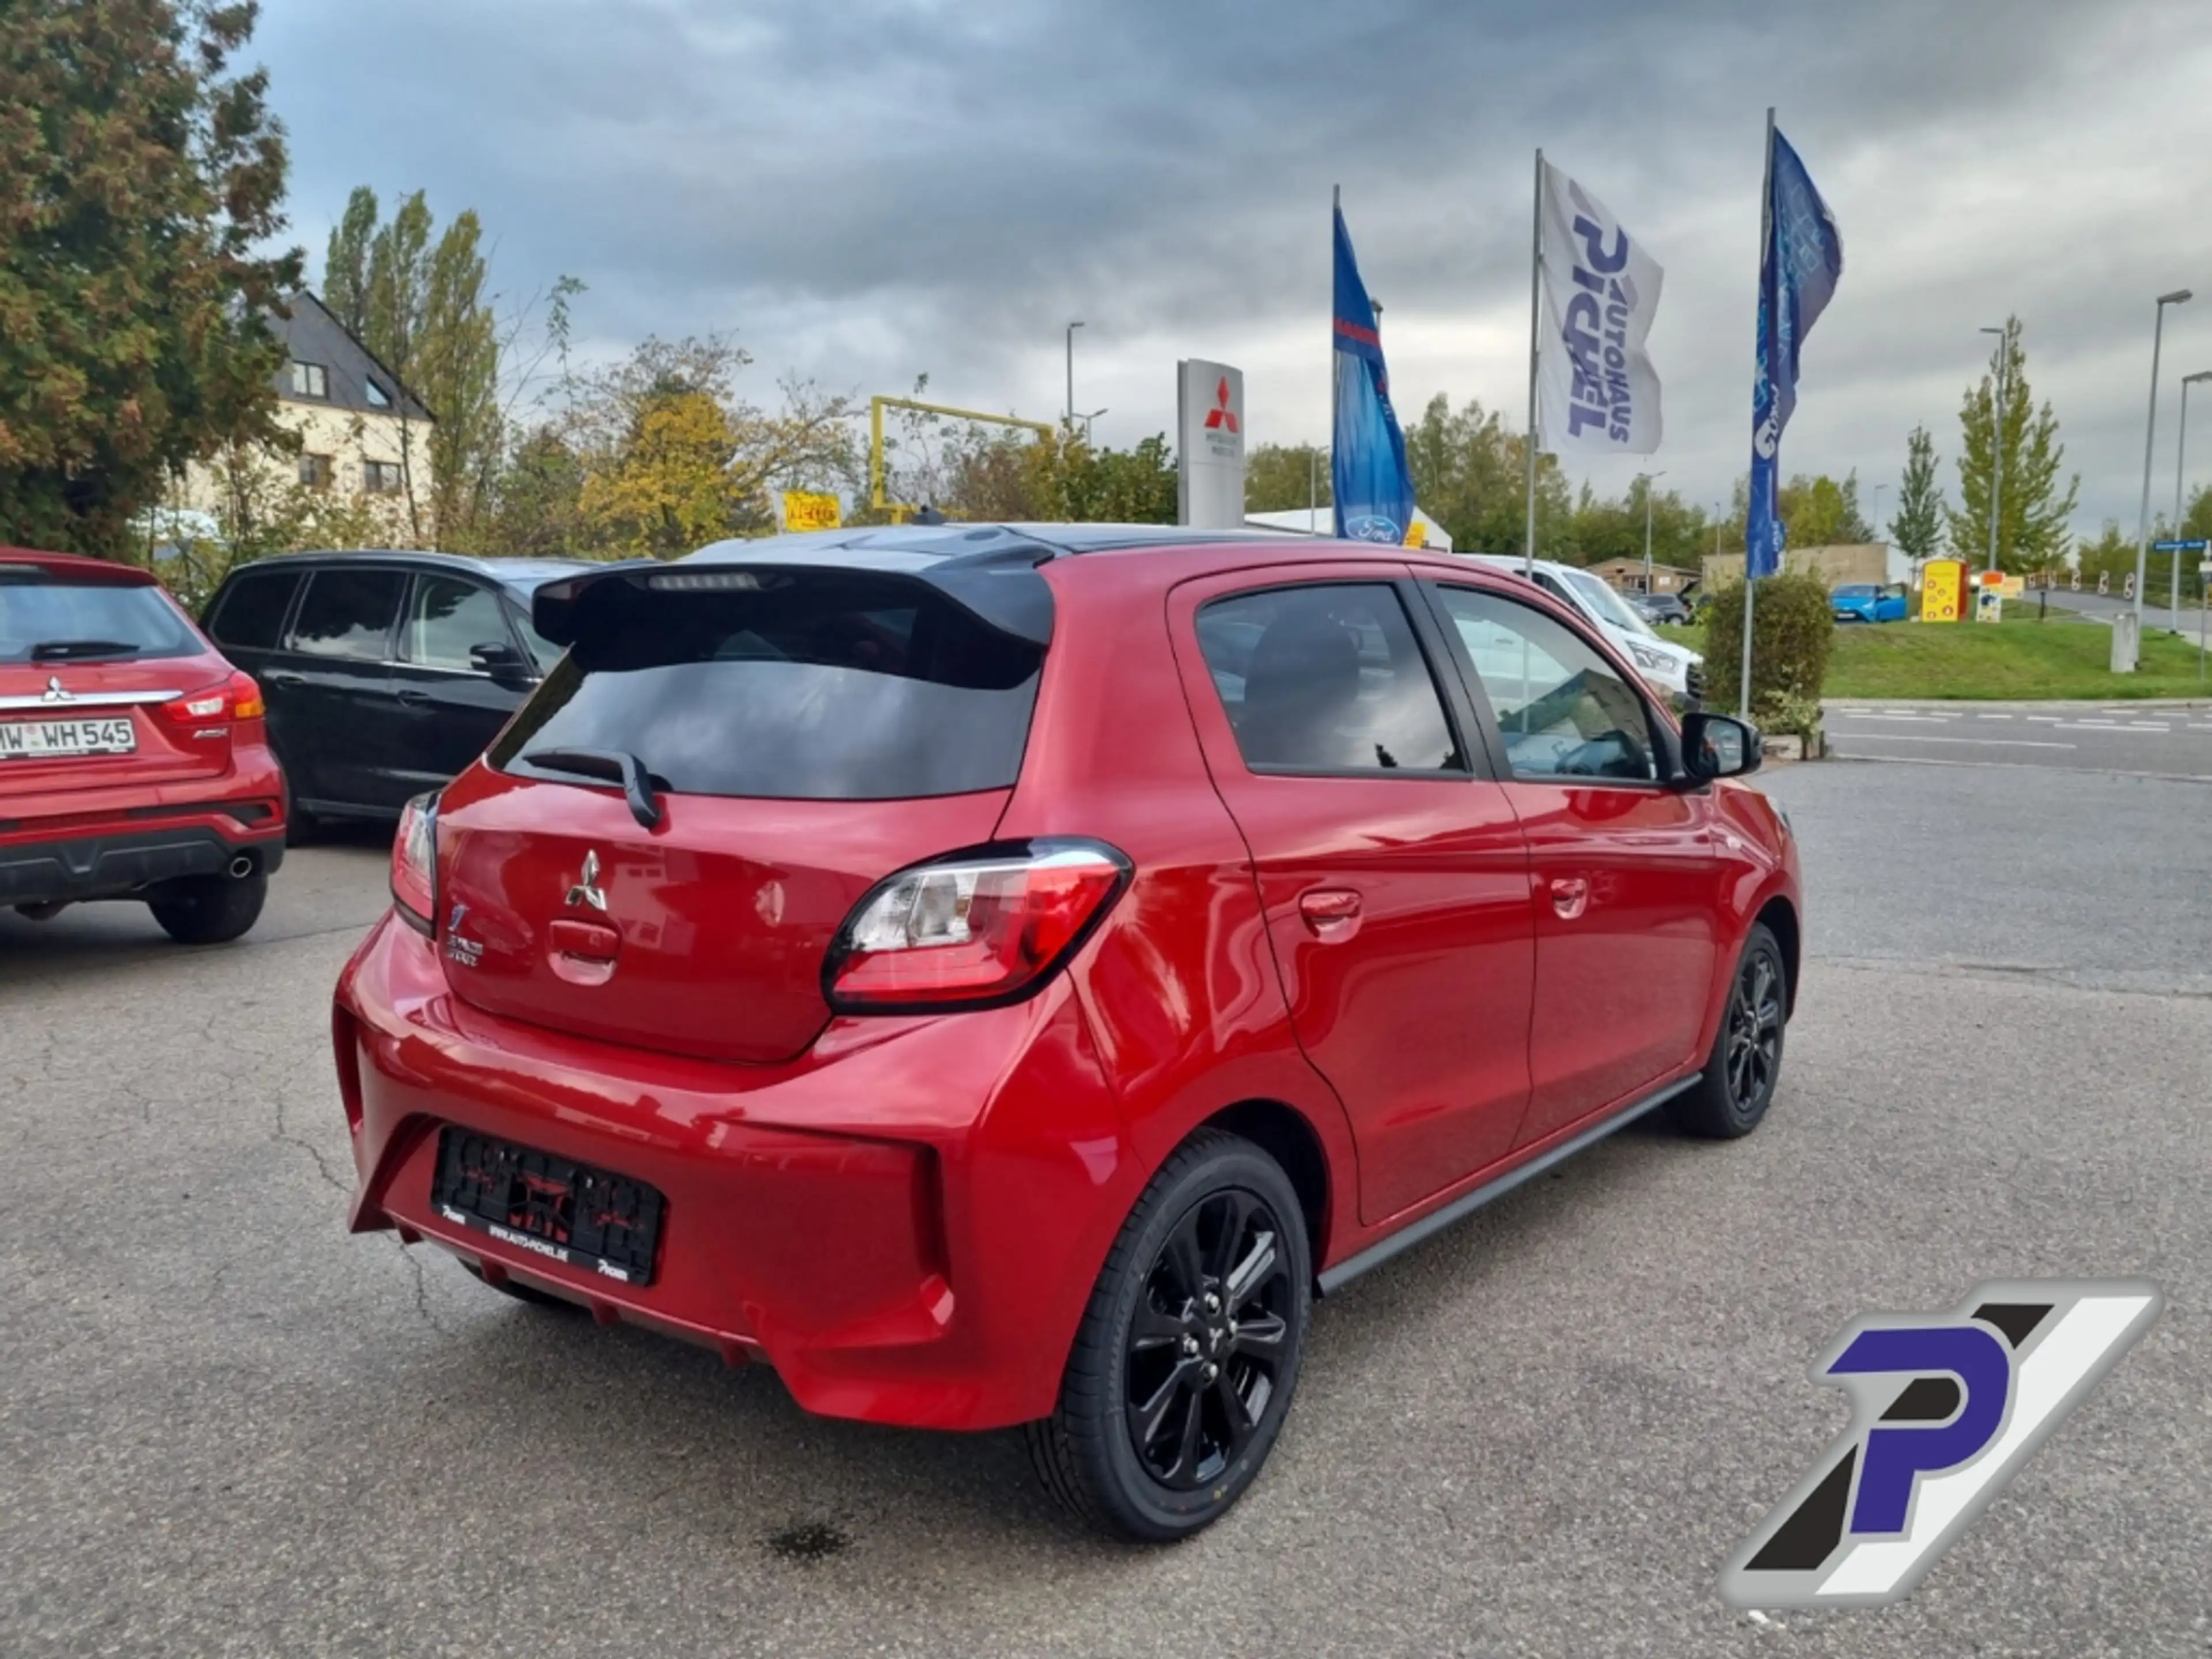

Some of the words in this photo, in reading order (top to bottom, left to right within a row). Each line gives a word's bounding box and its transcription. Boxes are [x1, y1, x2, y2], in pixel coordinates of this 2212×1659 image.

[1604, 278, 1631, 444] AUTOHAUS
[41, 724, 79, 748] WH
[82, 722, 131, 746] 545
